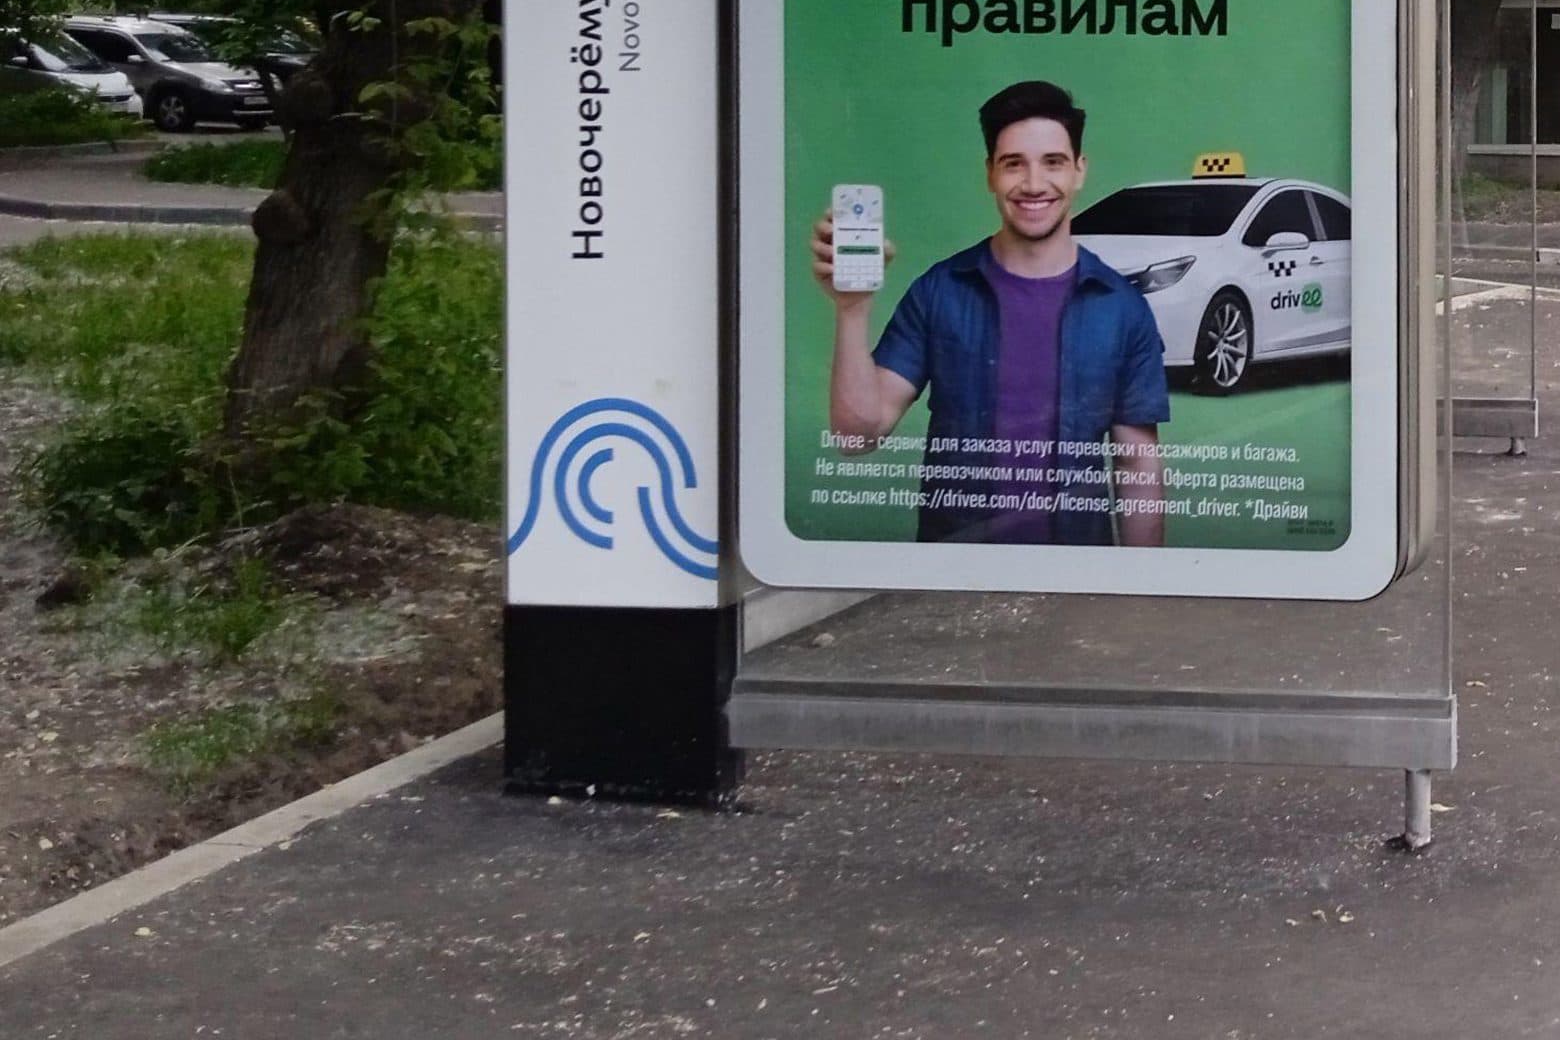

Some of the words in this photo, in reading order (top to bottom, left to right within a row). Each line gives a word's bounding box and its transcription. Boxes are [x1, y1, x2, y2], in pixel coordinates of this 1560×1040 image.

[1270, 287, 1323, 310] drivee
[821, 430, 864, 449] Drivee
[878, 436, 927, 451] сервис
[930, 437, 958, 453] для
[962, 437, 1010, 453] заказа
[1015, 438, 1054, 458] услуг
[1058, 440, 1135, 461] перевозки
[1138, 443, 1227, 462] пассажиров
[1231, 446, 1240, 458] и
[1243, 443, 1300, 462] багажа.
[816, 457, 833, 476] Не
[837, 460, 905, 477] является
[909, 463, 1012, 482] перевозчиком
[1015, 466, 1043, 482] или
[1047, 463, 1112, 486] службой
[1115, 470, 1159, 486] такси.
[1163, 467, 1217, 489] Оферта
[1220, 473, 1305, 491] размещена
[812, 489, 828, 504] по
[832, 489, 886, 506] ссылке
